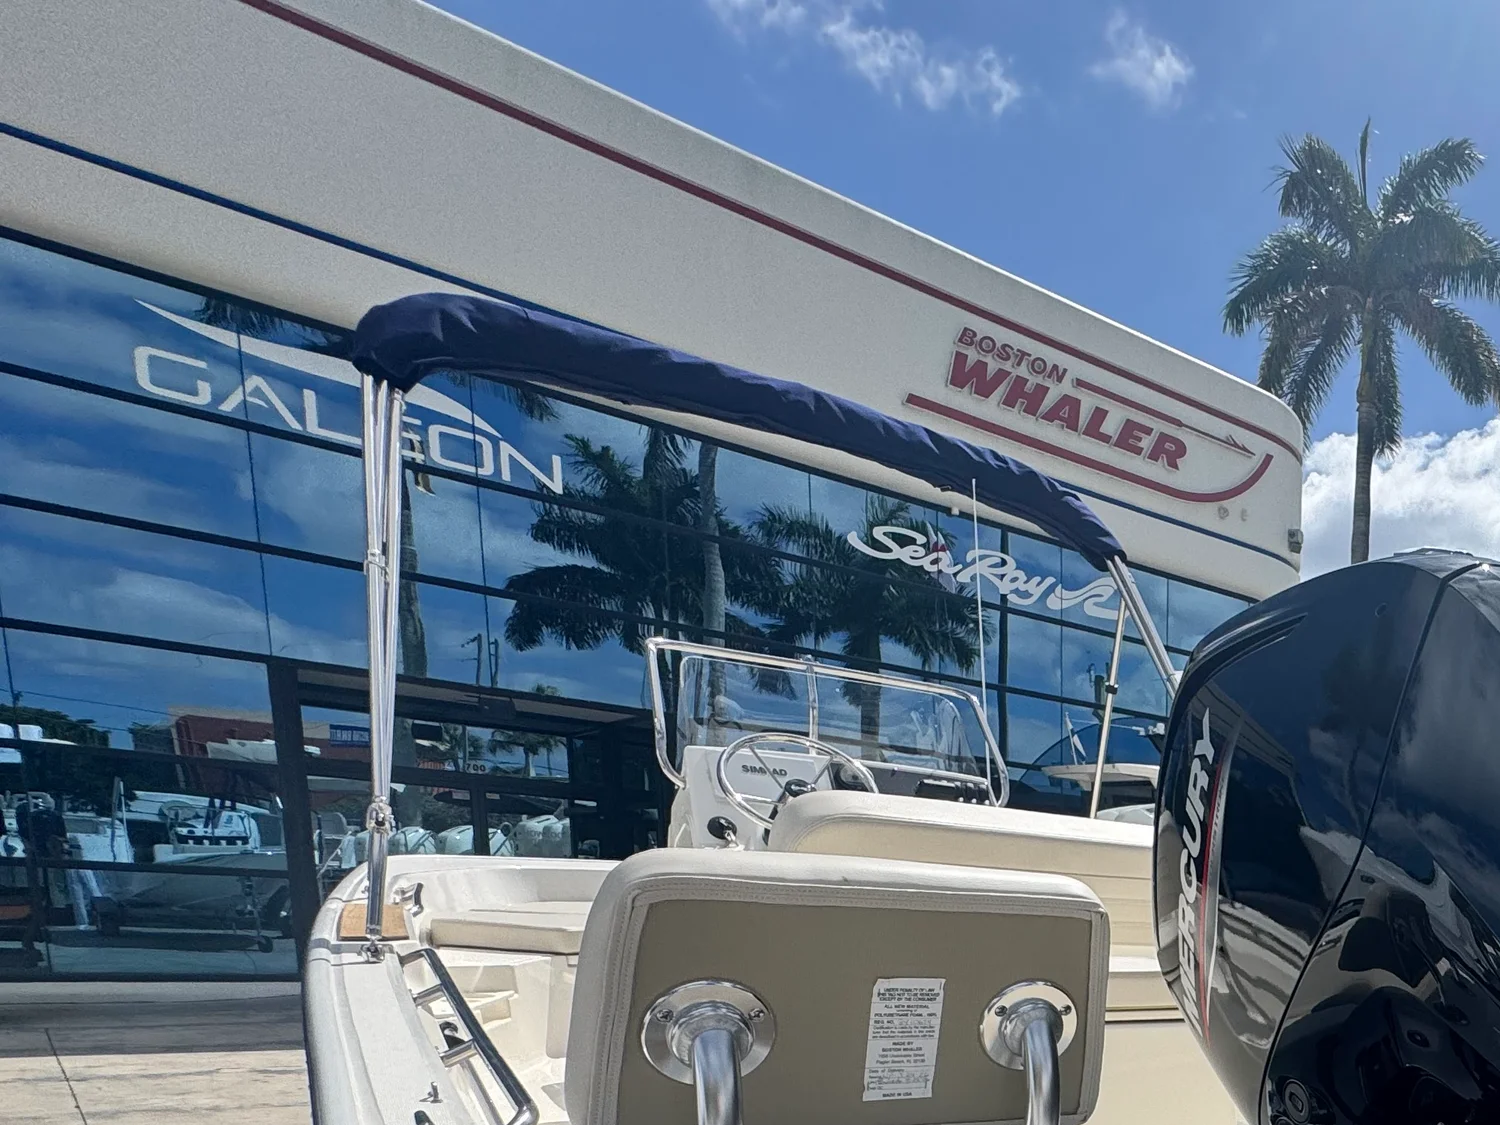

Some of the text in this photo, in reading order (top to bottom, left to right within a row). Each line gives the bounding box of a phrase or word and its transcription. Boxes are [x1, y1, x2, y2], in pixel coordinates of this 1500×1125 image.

[956, 326, 1069, 385] BOSTON
[947, 350, 1188, 471] WHALER
[847, 525, 1056, 605] Sea Ray
[741, 764, 788, 777] SIMAD
[1178, 707, 1215, 1038] MERCURY
